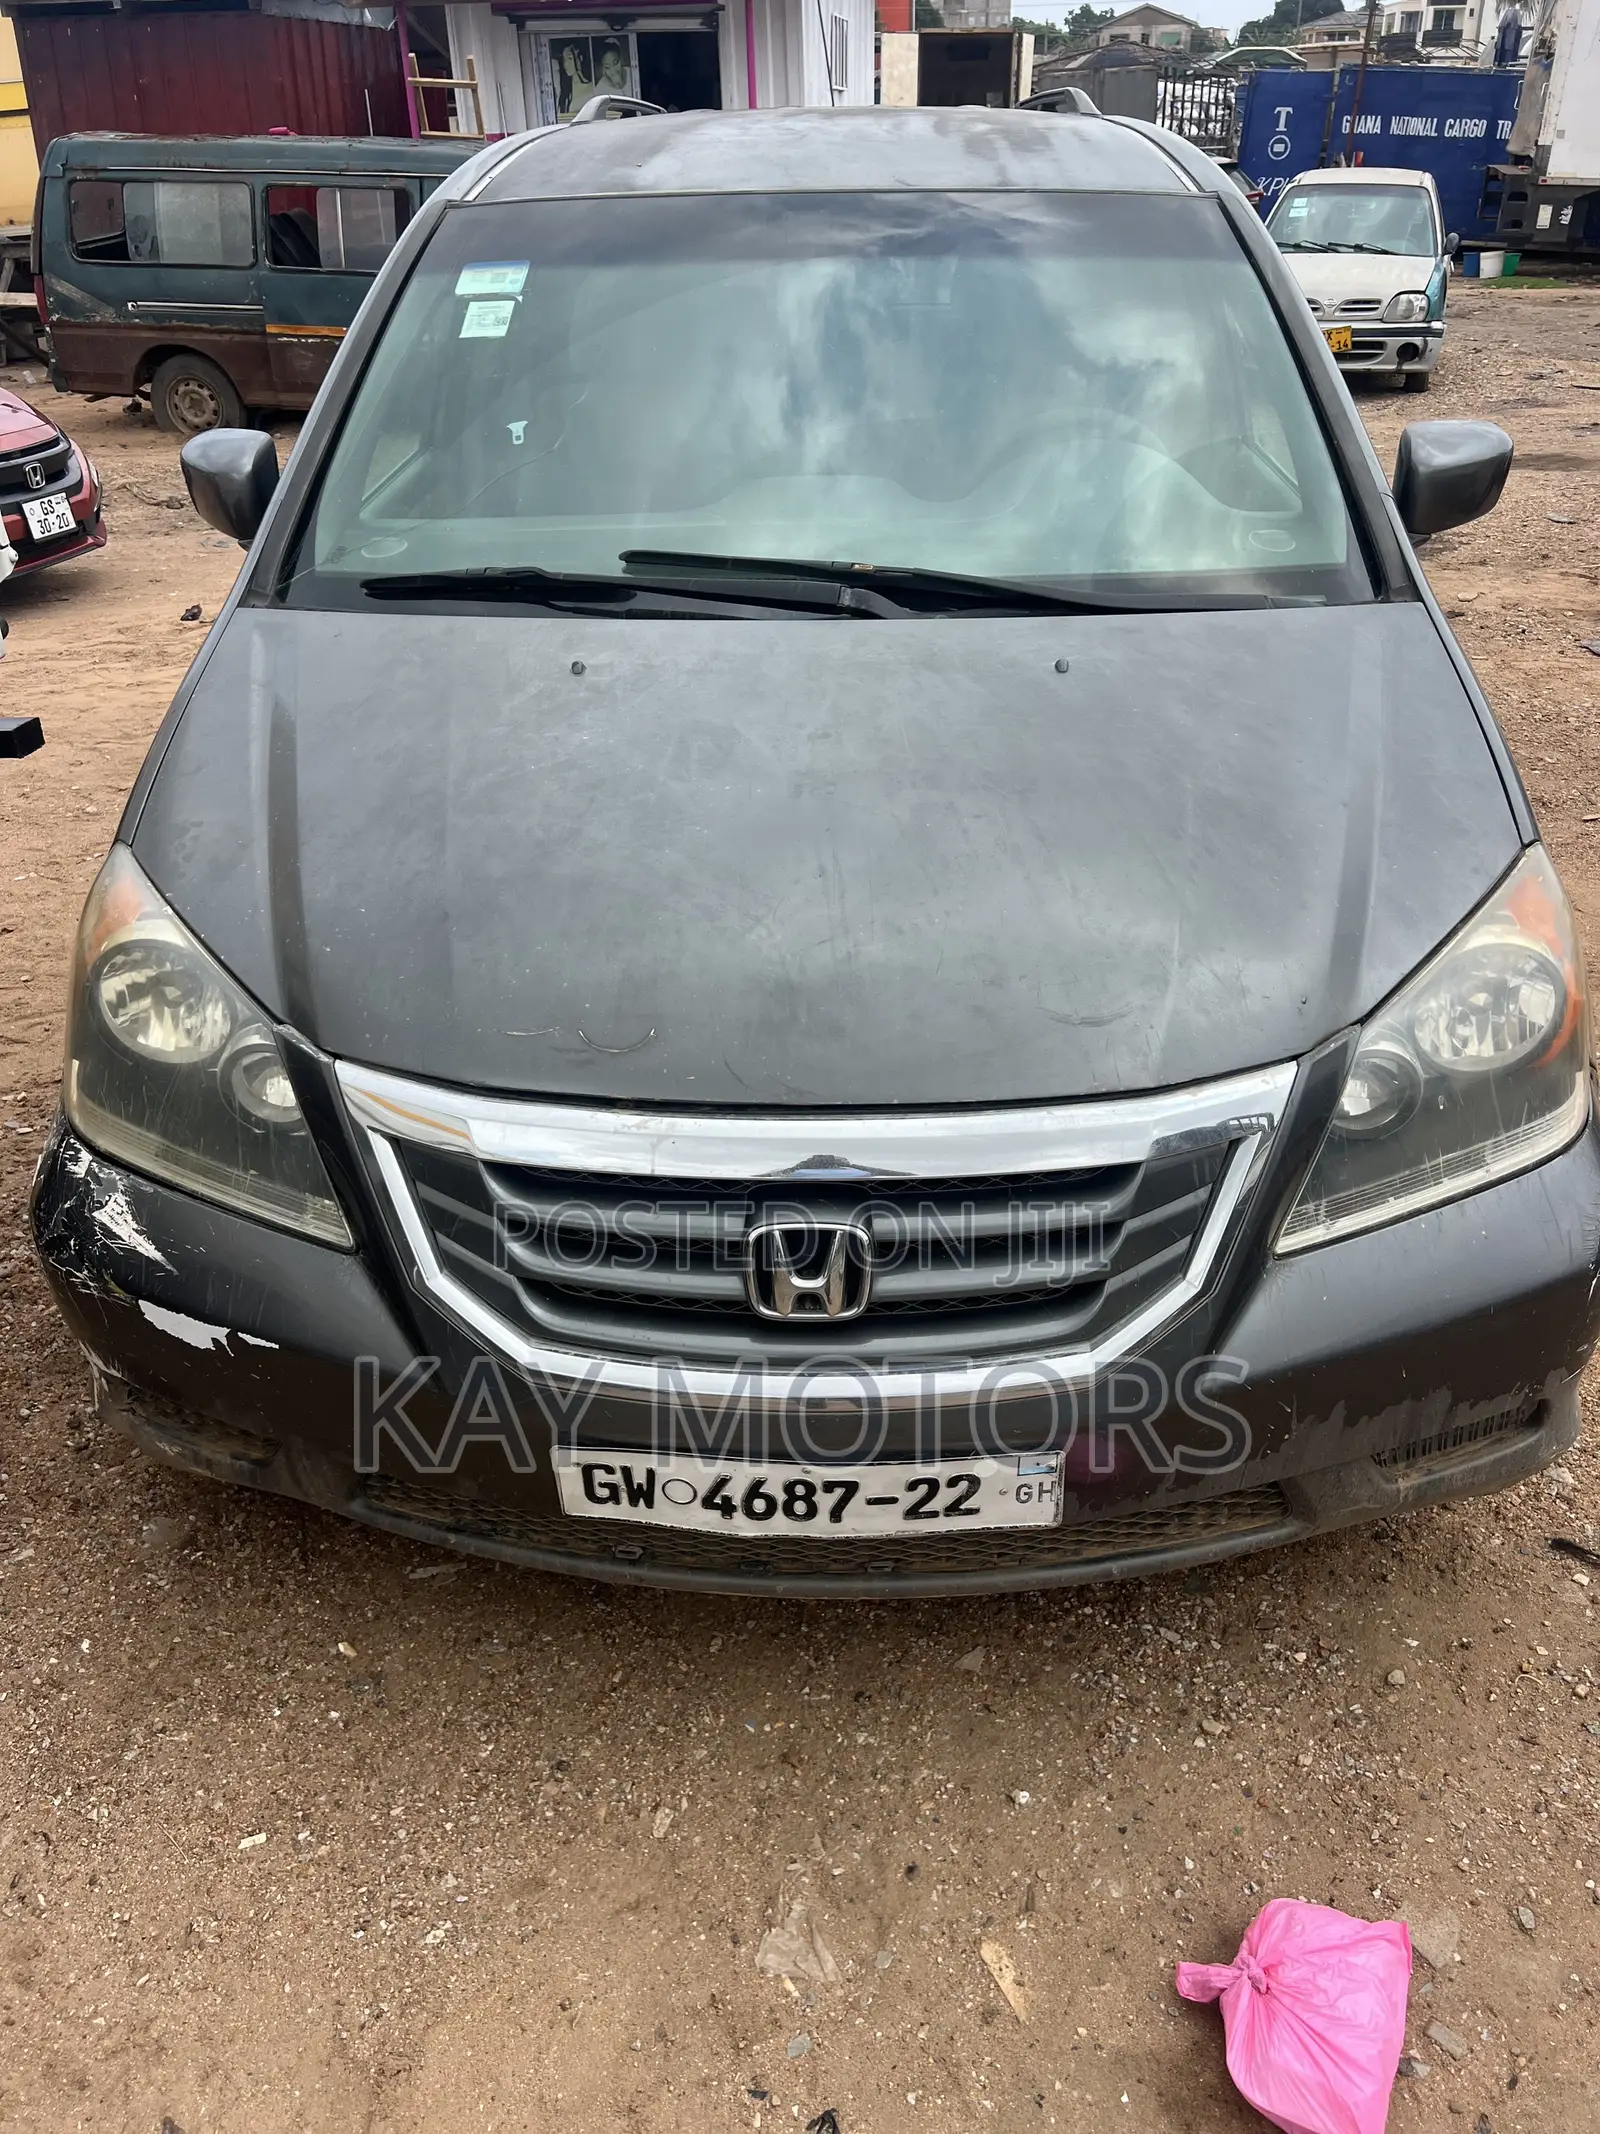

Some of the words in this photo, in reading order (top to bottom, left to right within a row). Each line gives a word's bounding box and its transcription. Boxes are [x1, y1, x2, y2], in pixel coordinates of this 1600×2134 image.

[1389, 115, 1438, 137] NATIONAL
[1444, 118, 1487, 138] CARGO
[1496, 119, 1513, 140] TR
[581, 1461, 656, 1510] GW
[701, 1472, 982, 1524] 4687-22
[1015, 1480, 1057, 1504] GH
